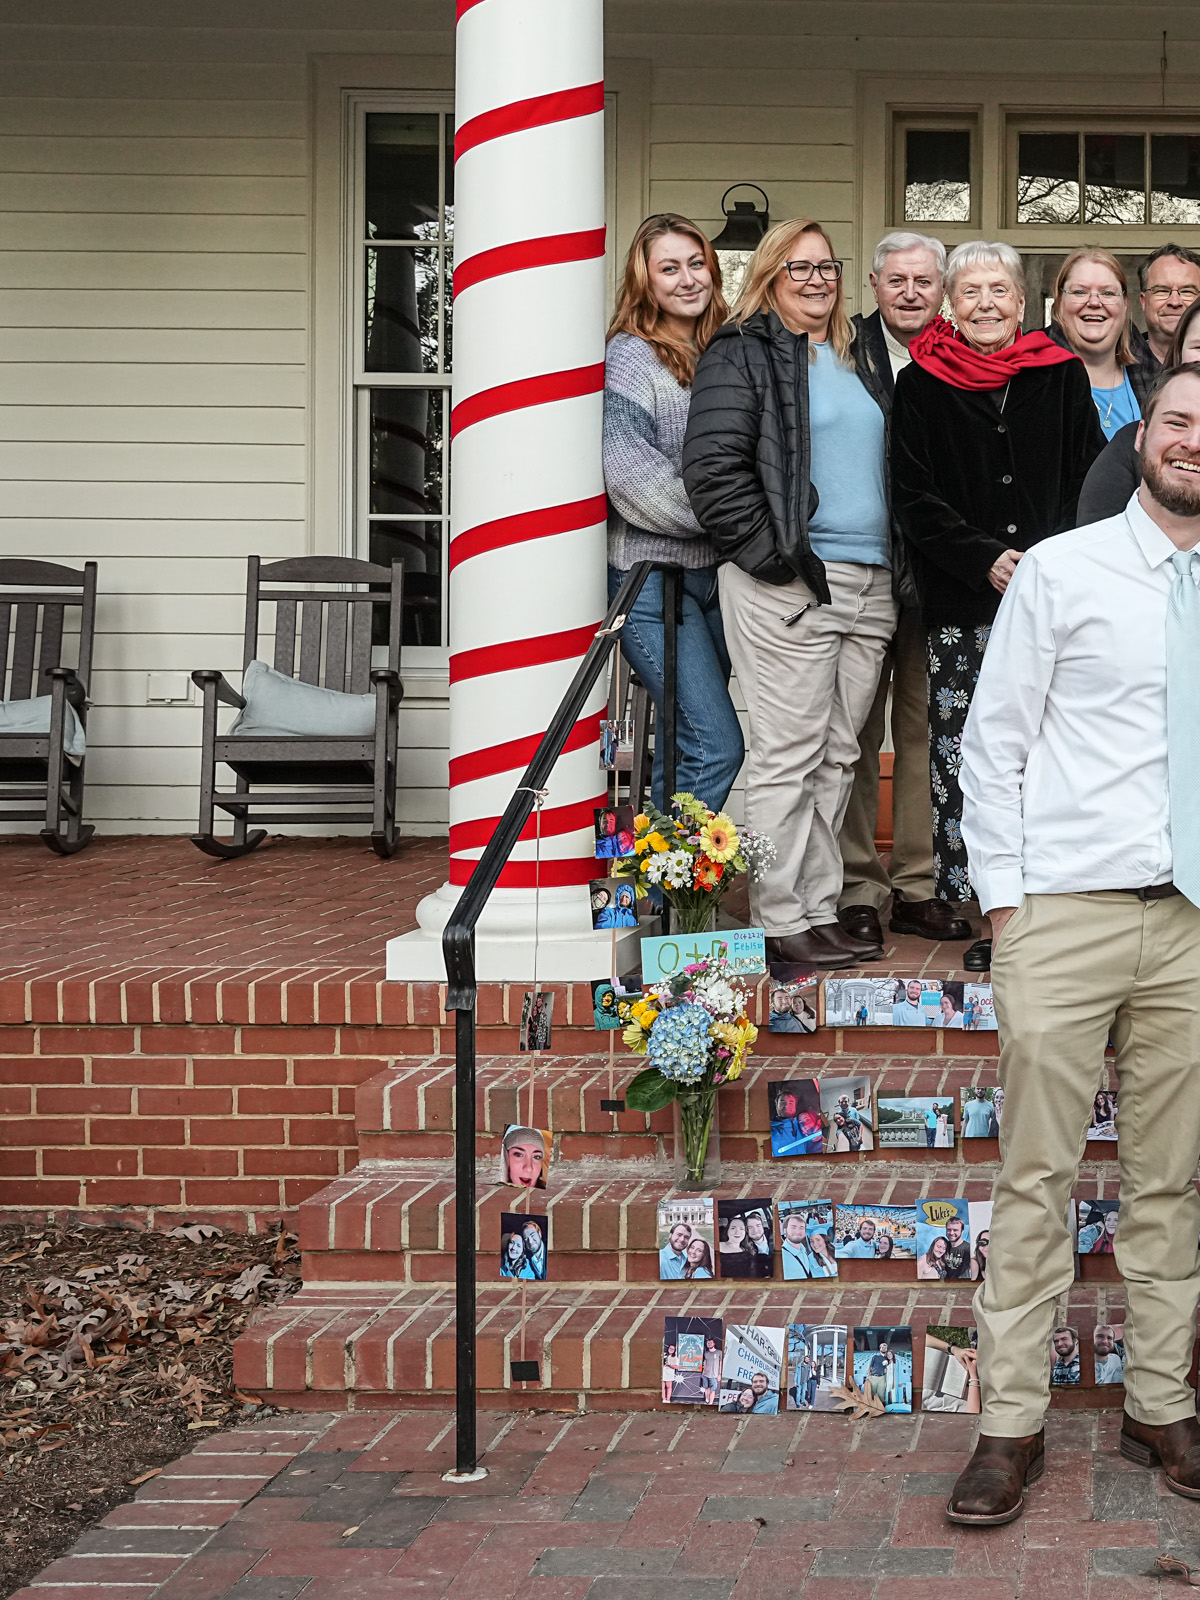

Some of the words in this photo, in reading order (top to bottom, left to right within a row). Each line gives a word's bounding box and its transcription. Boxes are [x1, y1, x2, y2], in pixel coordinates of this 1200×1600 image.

[733, 932, 747, 940] Oct
[734, 942, 750, 952] Feb
[737, 1367, 752, 1380] FRE
